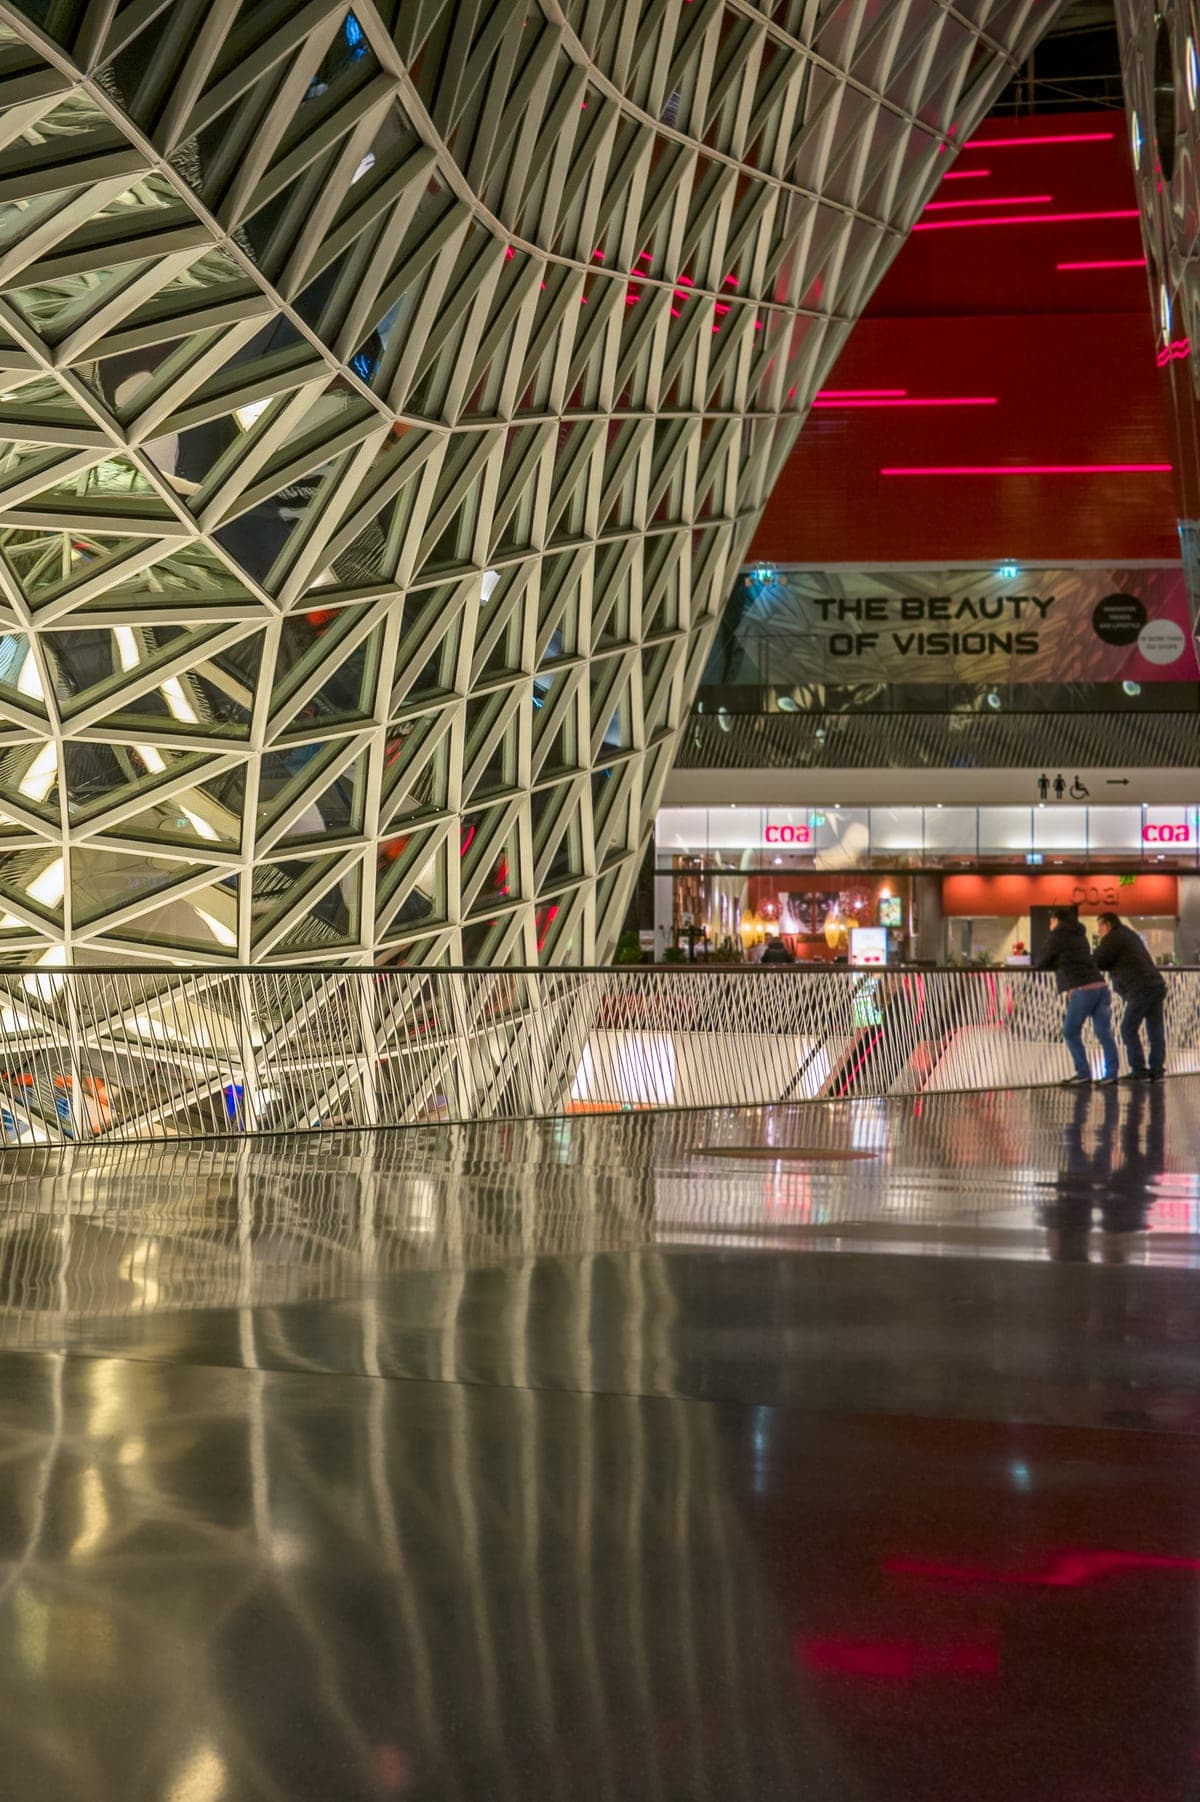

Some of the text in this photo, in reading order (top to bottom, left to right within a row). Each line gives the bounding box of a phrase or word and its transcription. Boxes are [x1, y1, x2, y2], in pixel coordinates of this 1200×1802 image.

[813, 596, 1055, 621] THE BEAUTY
[829, 631, 1040, 656] OF VISIONS
[764, 825, 810, 843] coa
[1141, 824, 1190, 842] coa
